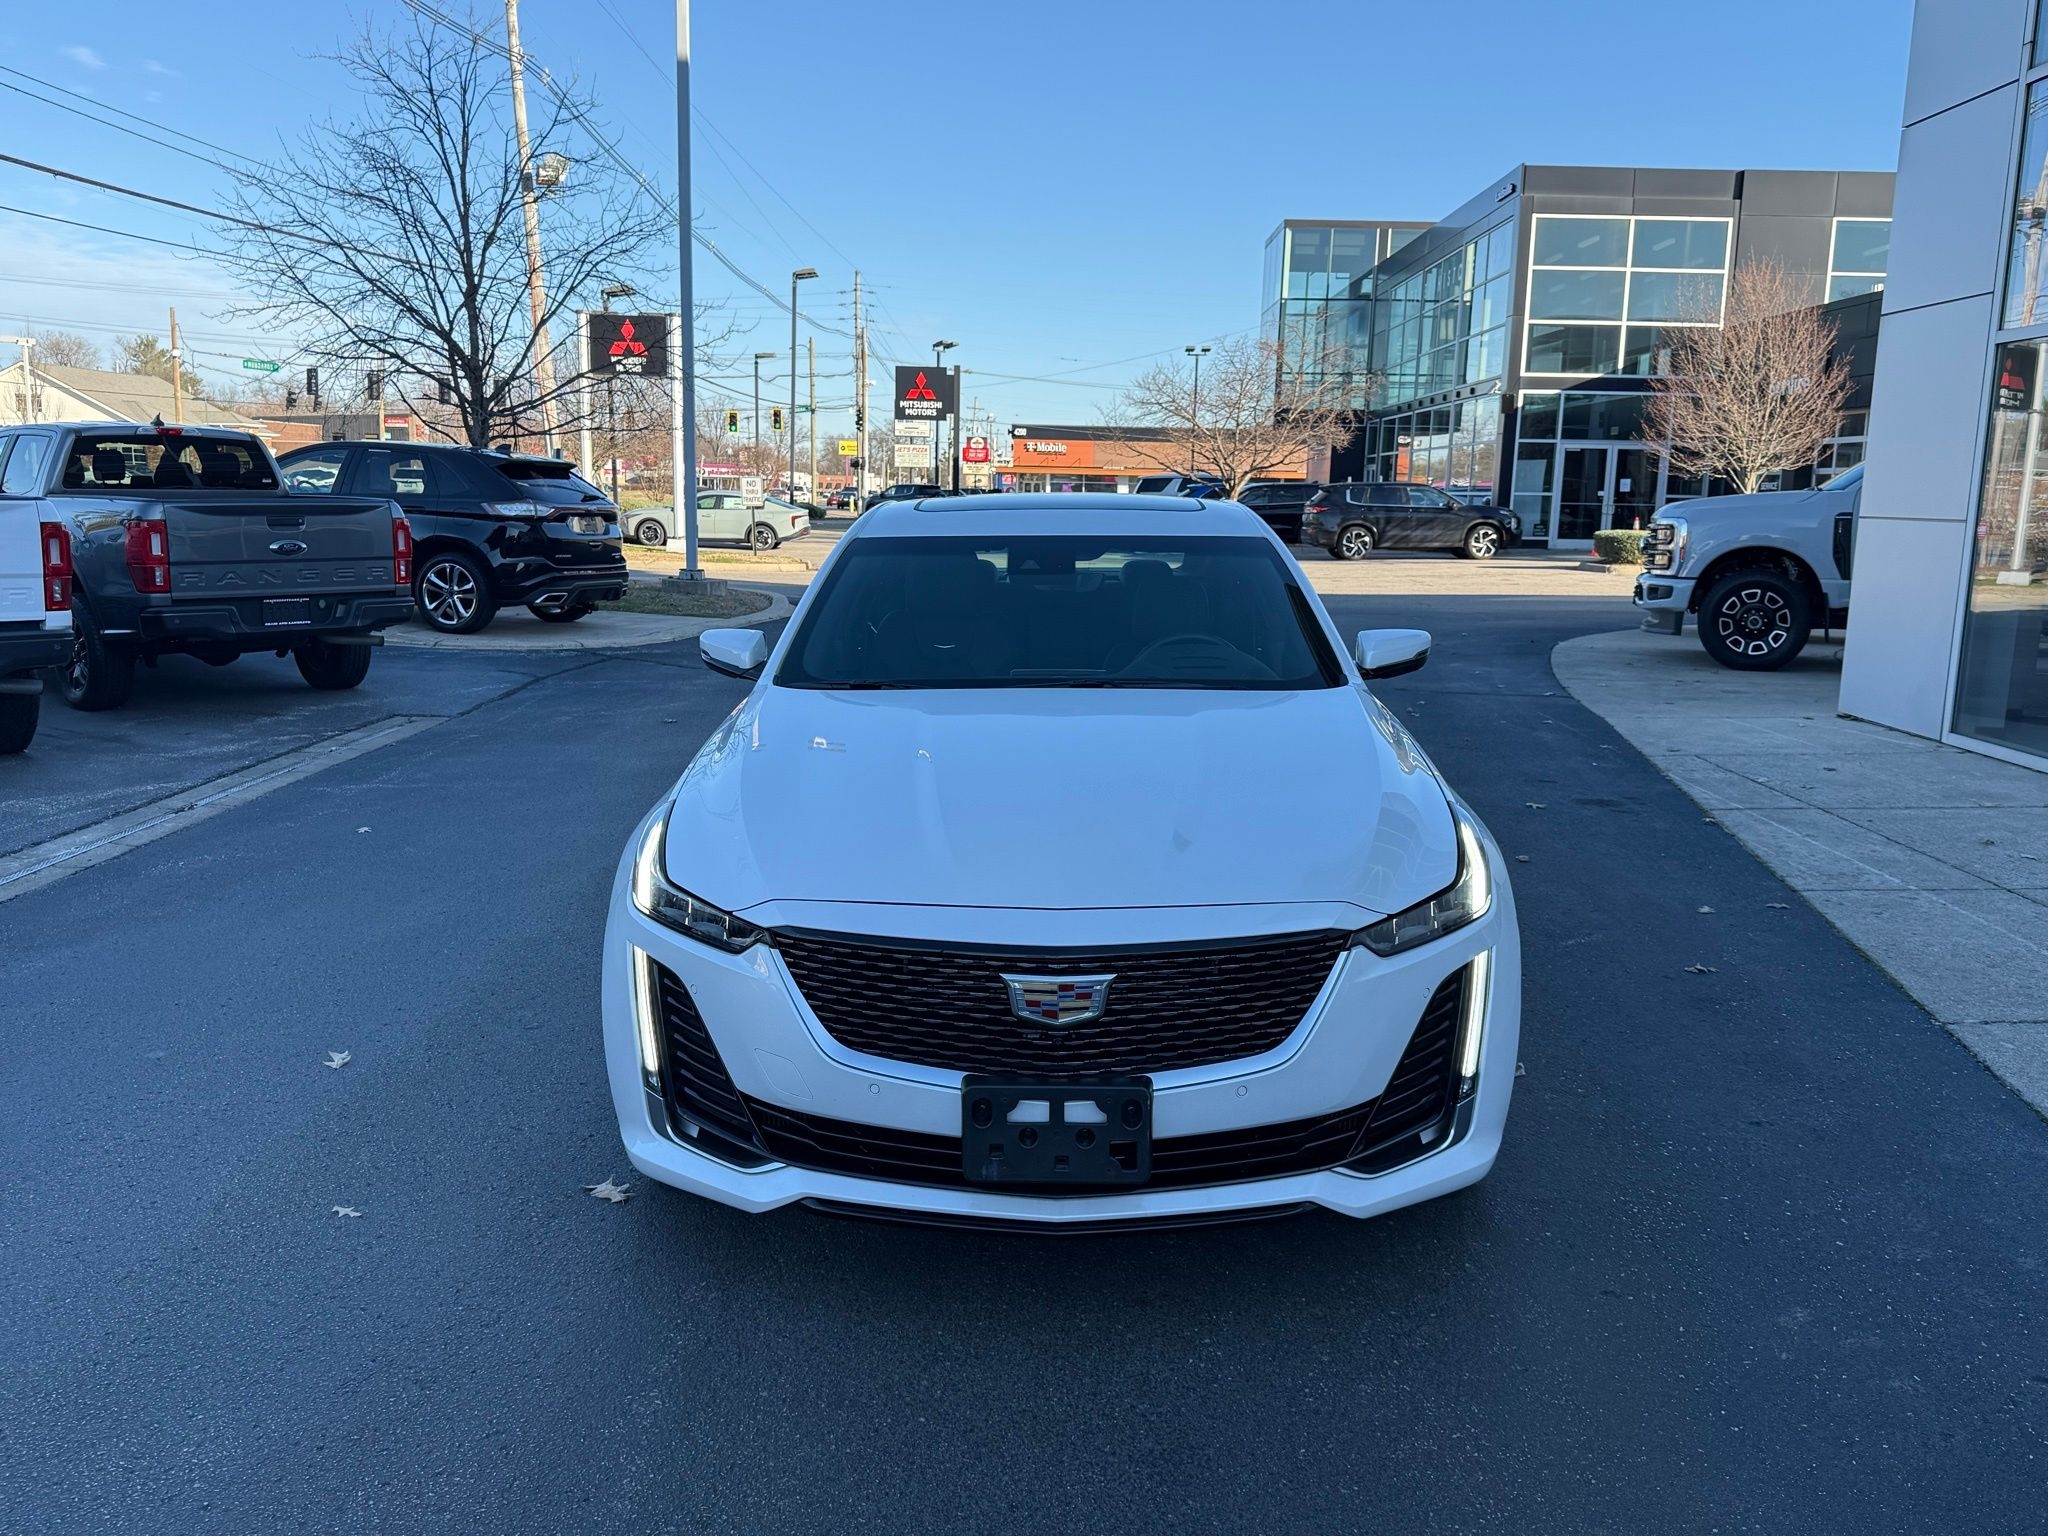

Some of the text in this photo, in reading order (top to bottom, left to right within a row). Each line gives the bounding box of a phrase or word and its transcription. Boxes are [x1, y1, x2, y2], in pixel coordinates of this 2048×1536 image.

[899, 400, 943, 409] MITSUBISHI
[905, 408, 937, 416] MOTORS
[178, 566, 390, 587] RANGER
